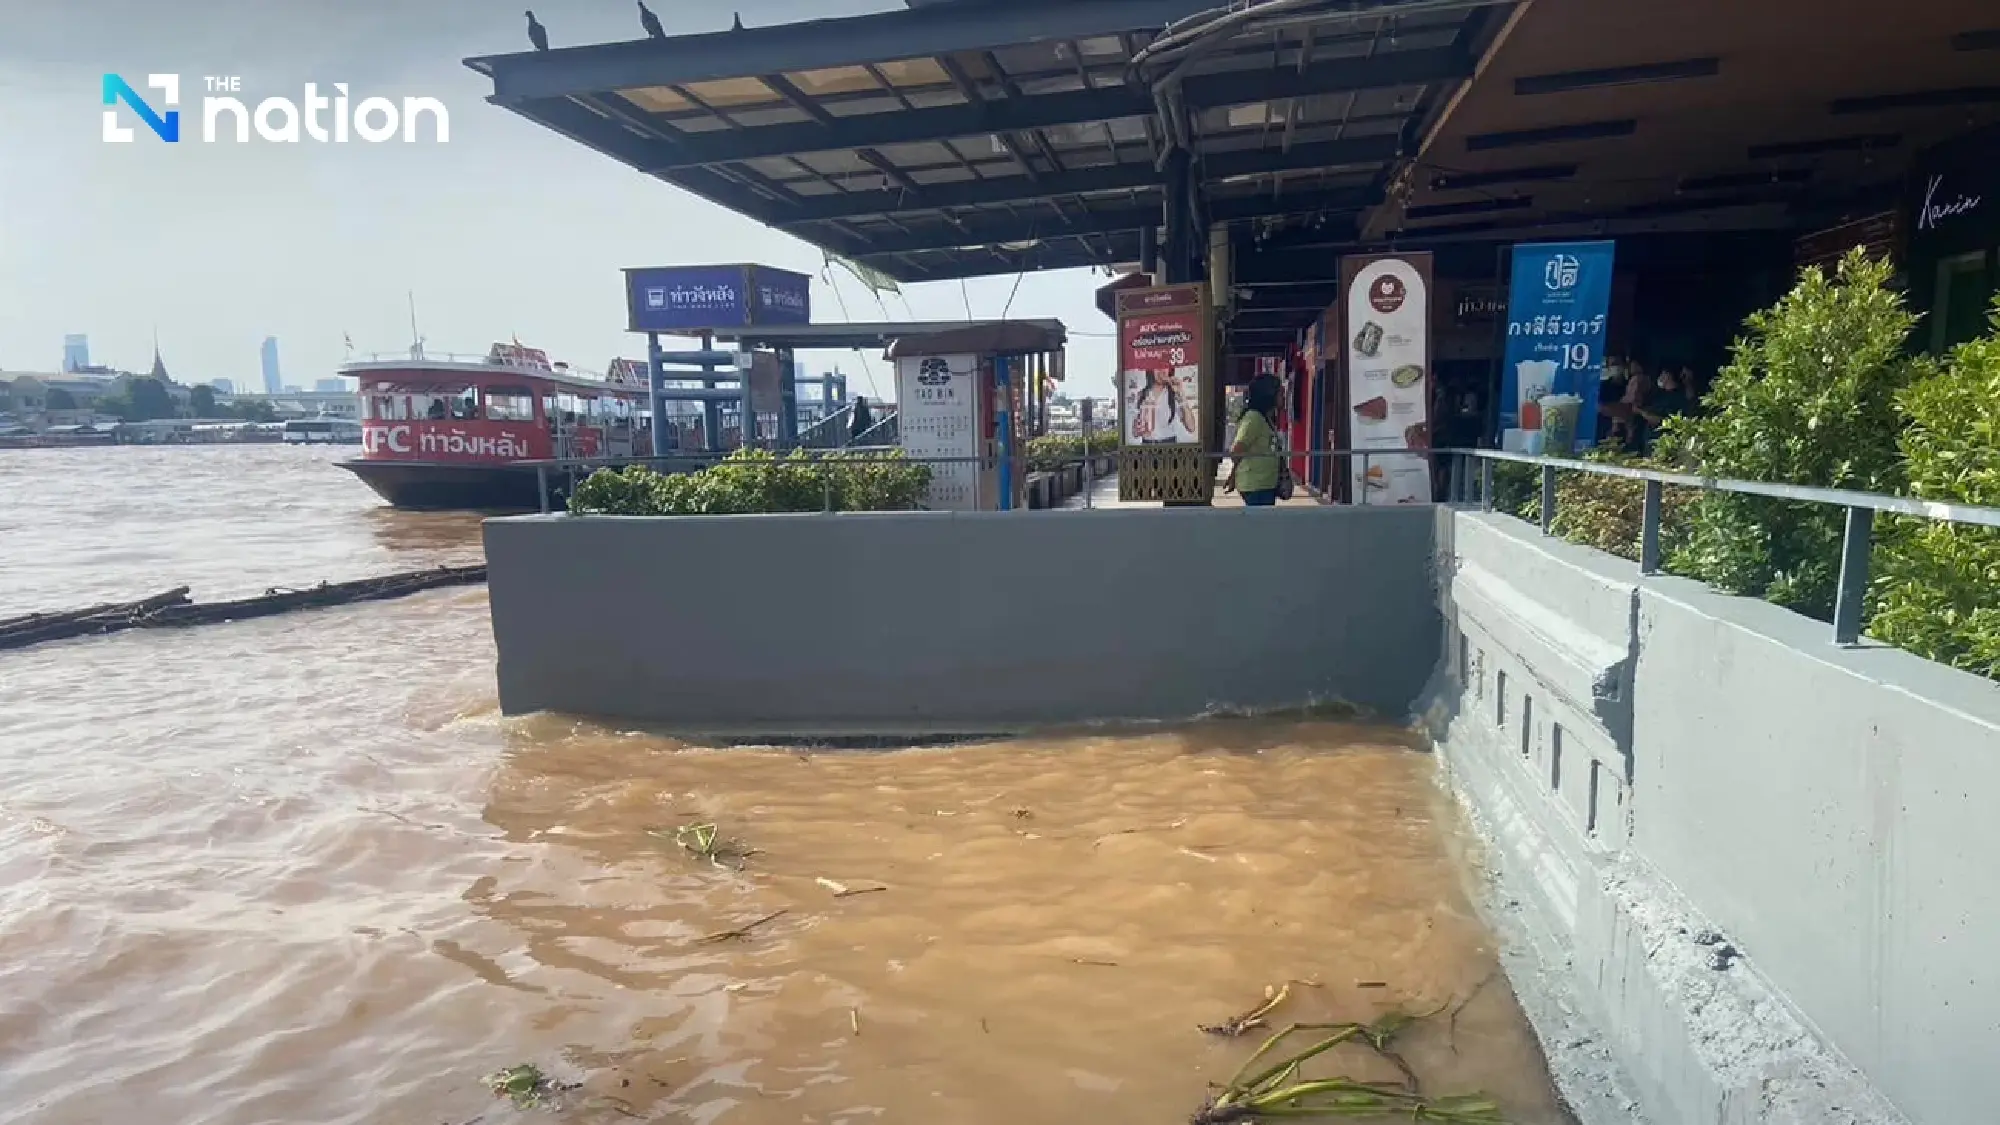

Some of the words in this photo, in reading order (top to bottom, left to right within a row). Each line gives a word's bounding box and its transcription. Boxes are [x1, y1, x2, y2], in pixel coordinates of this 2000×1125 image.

[669, 284, 735, 303] ท่าวังหลัง
[1170, 347, 1184, 365] 39
[1562, 343, 1589, 370] 19
[420, 425, 529, 459] ท่าวังหลัง
